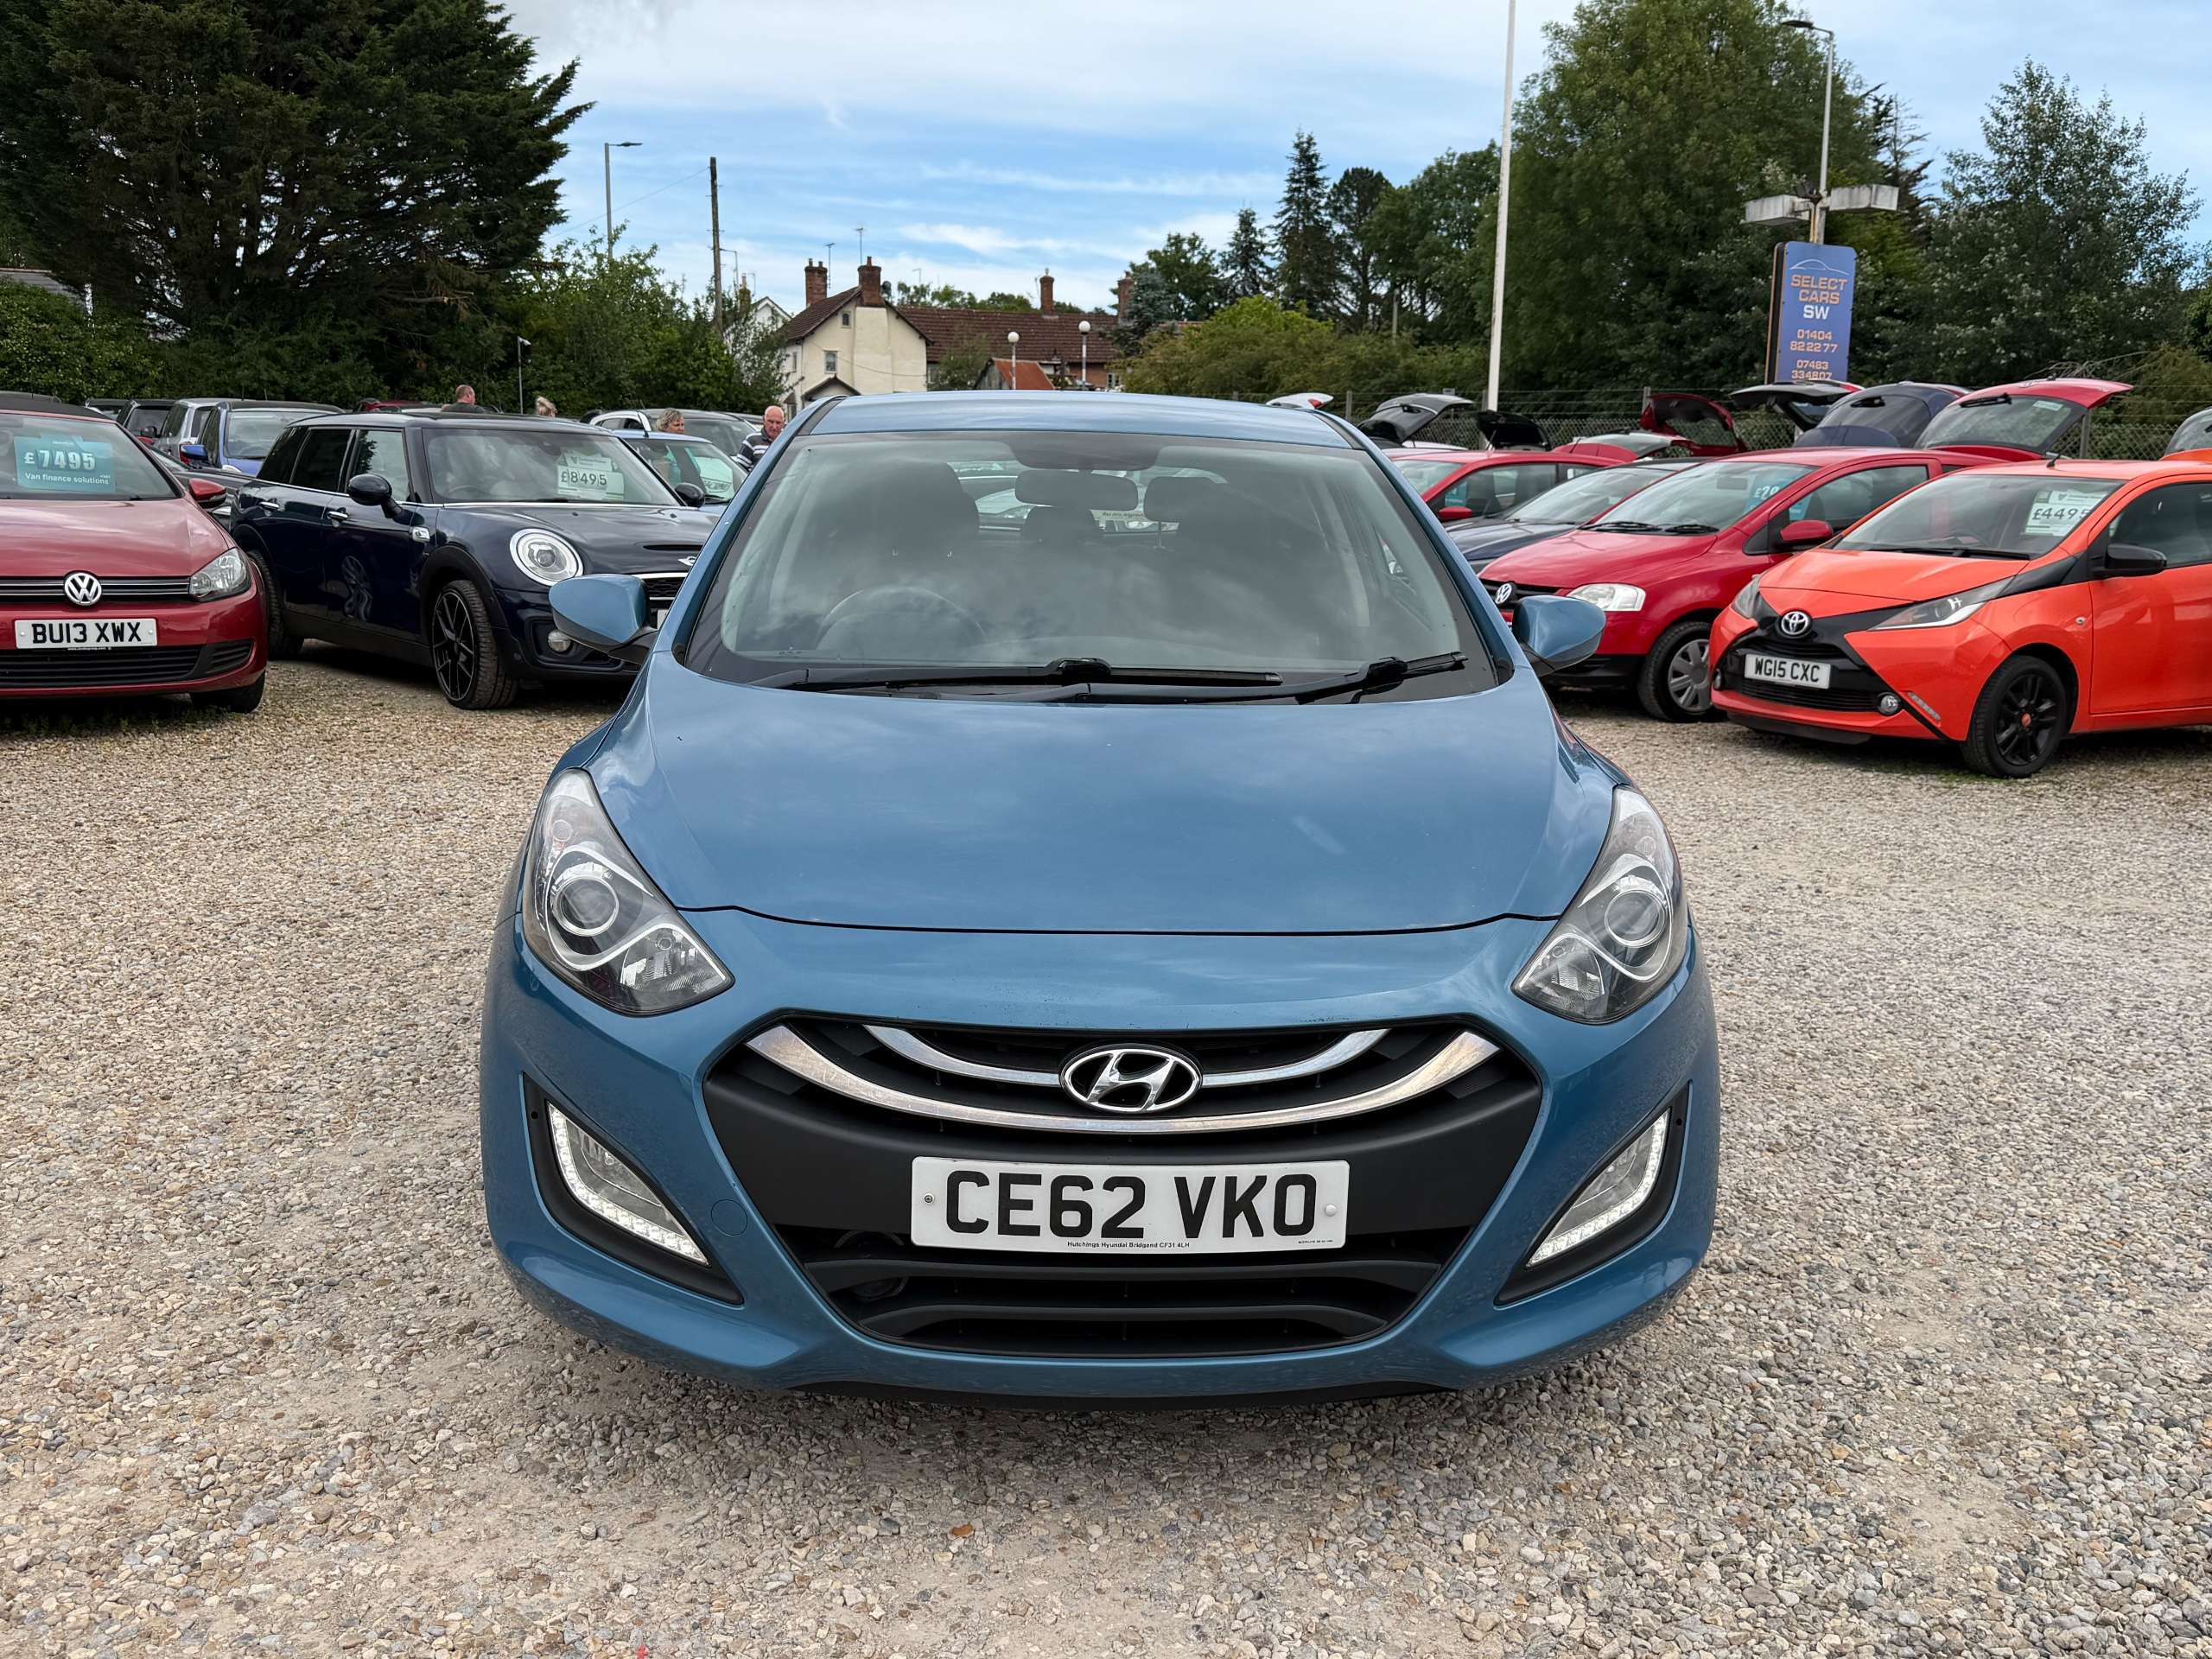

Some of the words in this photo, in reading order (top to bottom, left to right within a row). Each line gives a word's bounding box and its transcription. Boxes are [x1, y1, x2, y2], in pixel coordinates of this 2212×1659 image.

[1791, 275, 1847, 290] SELECT
[1799, 289, 1840, 304] CARS
[1803, 305, 1830, 320] SW
[1797, 329, 1832, 340] 01404
[42, 474, 72, 483] finance
[73, 476, 109, 485] solutions
[561, 471, 607, 486] £8495
[31, 623, 87, 644] BU13
[95, 622, 141, 643] XWX
[1755, 657, 1786, 678] WG15
[1790, 663, 1820, 683] CXC
[946, 1170, 1146, 1239] CE62
[1173, 1173, 1317, 1239] VKO
